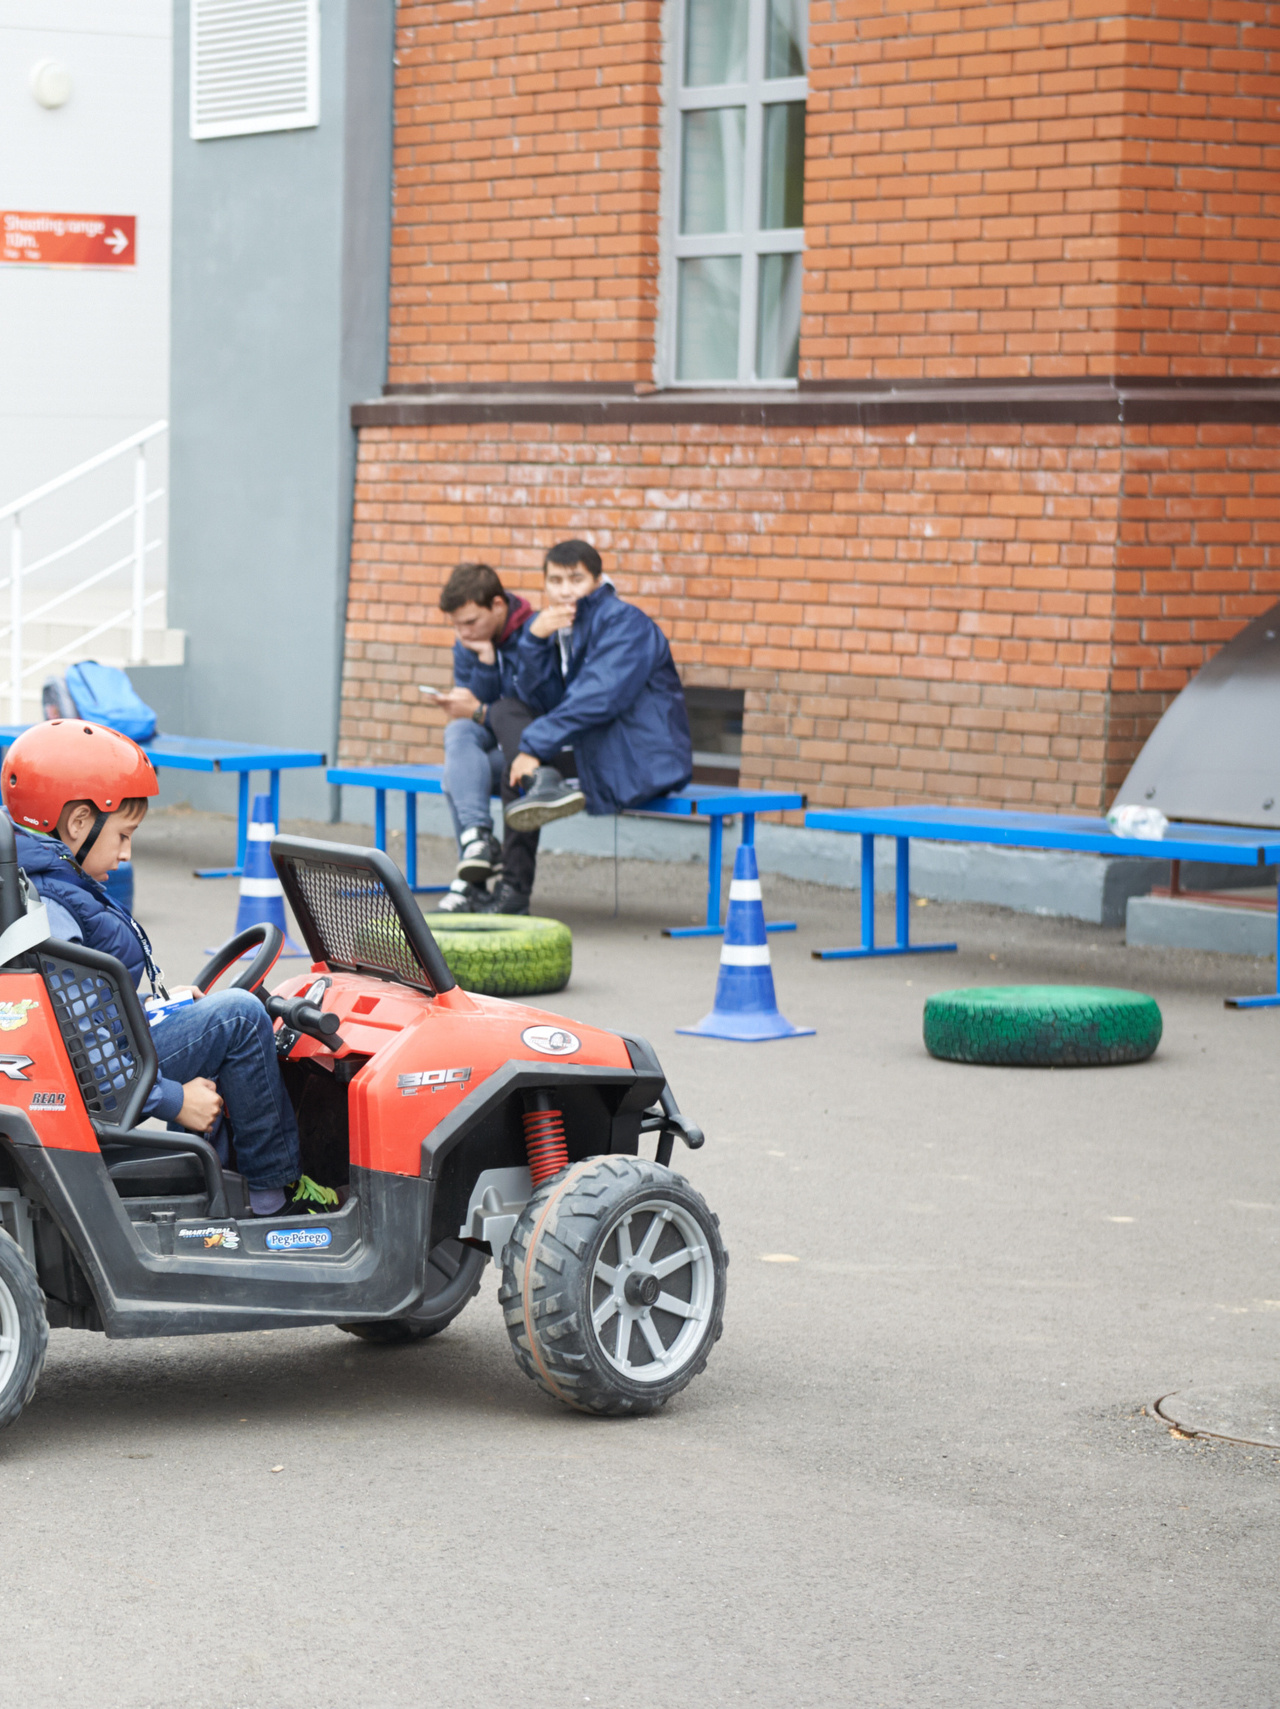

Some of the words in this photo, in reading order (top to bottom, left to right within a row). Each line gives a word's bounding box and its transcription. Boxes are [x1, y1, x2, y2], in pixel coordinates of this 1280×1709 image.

[4, 214, 65, 237] Shooting
[66, 219, 106, 238] range
[397, 1067, 472, 1089] 800
[31, 1092, 66, 1105] REAR
[271, 1230, 328, 1247] Peg-Pérego
